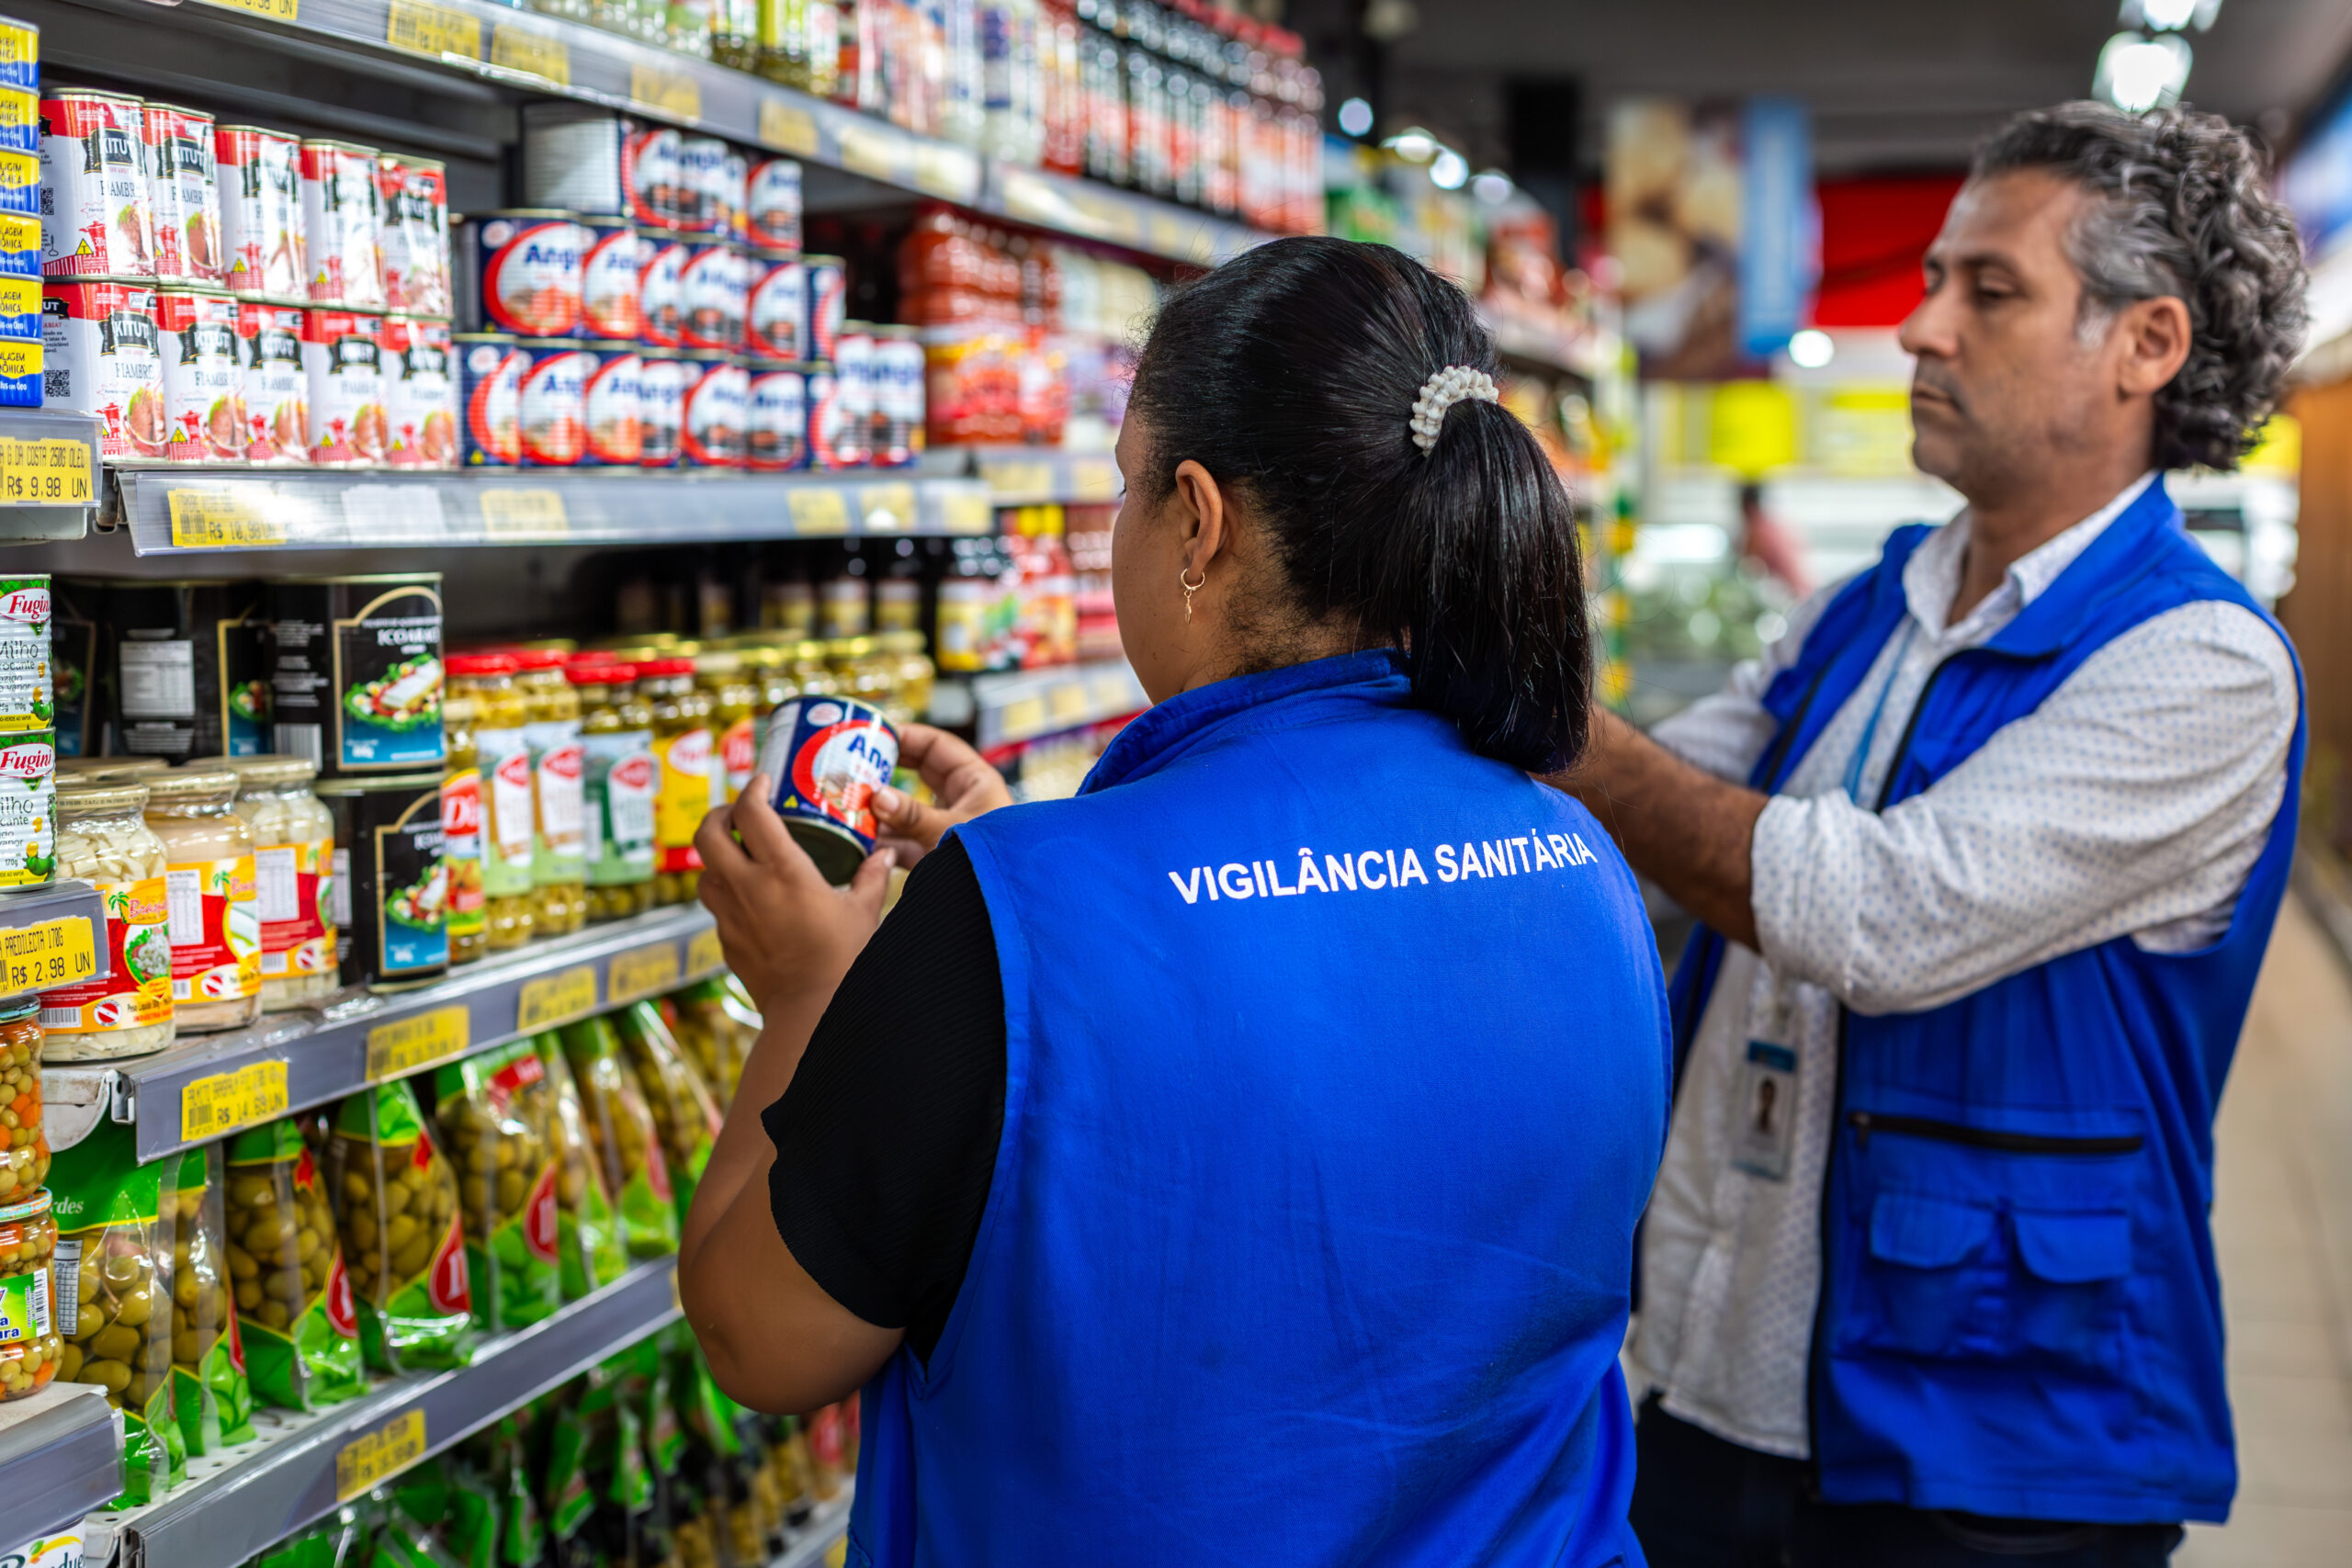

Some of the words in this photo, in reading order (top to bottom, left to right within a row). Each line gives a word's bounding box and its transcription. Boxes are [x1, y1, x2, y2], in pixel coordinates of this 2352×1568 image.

[112, 320, 149, 339] KITUT
[27, 446, 47, 468] COSTA
[7, 476, 23, 497] R$
[72, 477, 87, 498] UN
[1, 750, 51, 775] Fugini
[1168, 847, 1429, 904] VIGILÂNCIA
[1434, 828, 1598, 883] SANITÁRIA
[6, 930, 45, 957] PREDILECTA
[12, 965, 28, 987] R$
[74, 951, 91, 973] UN
